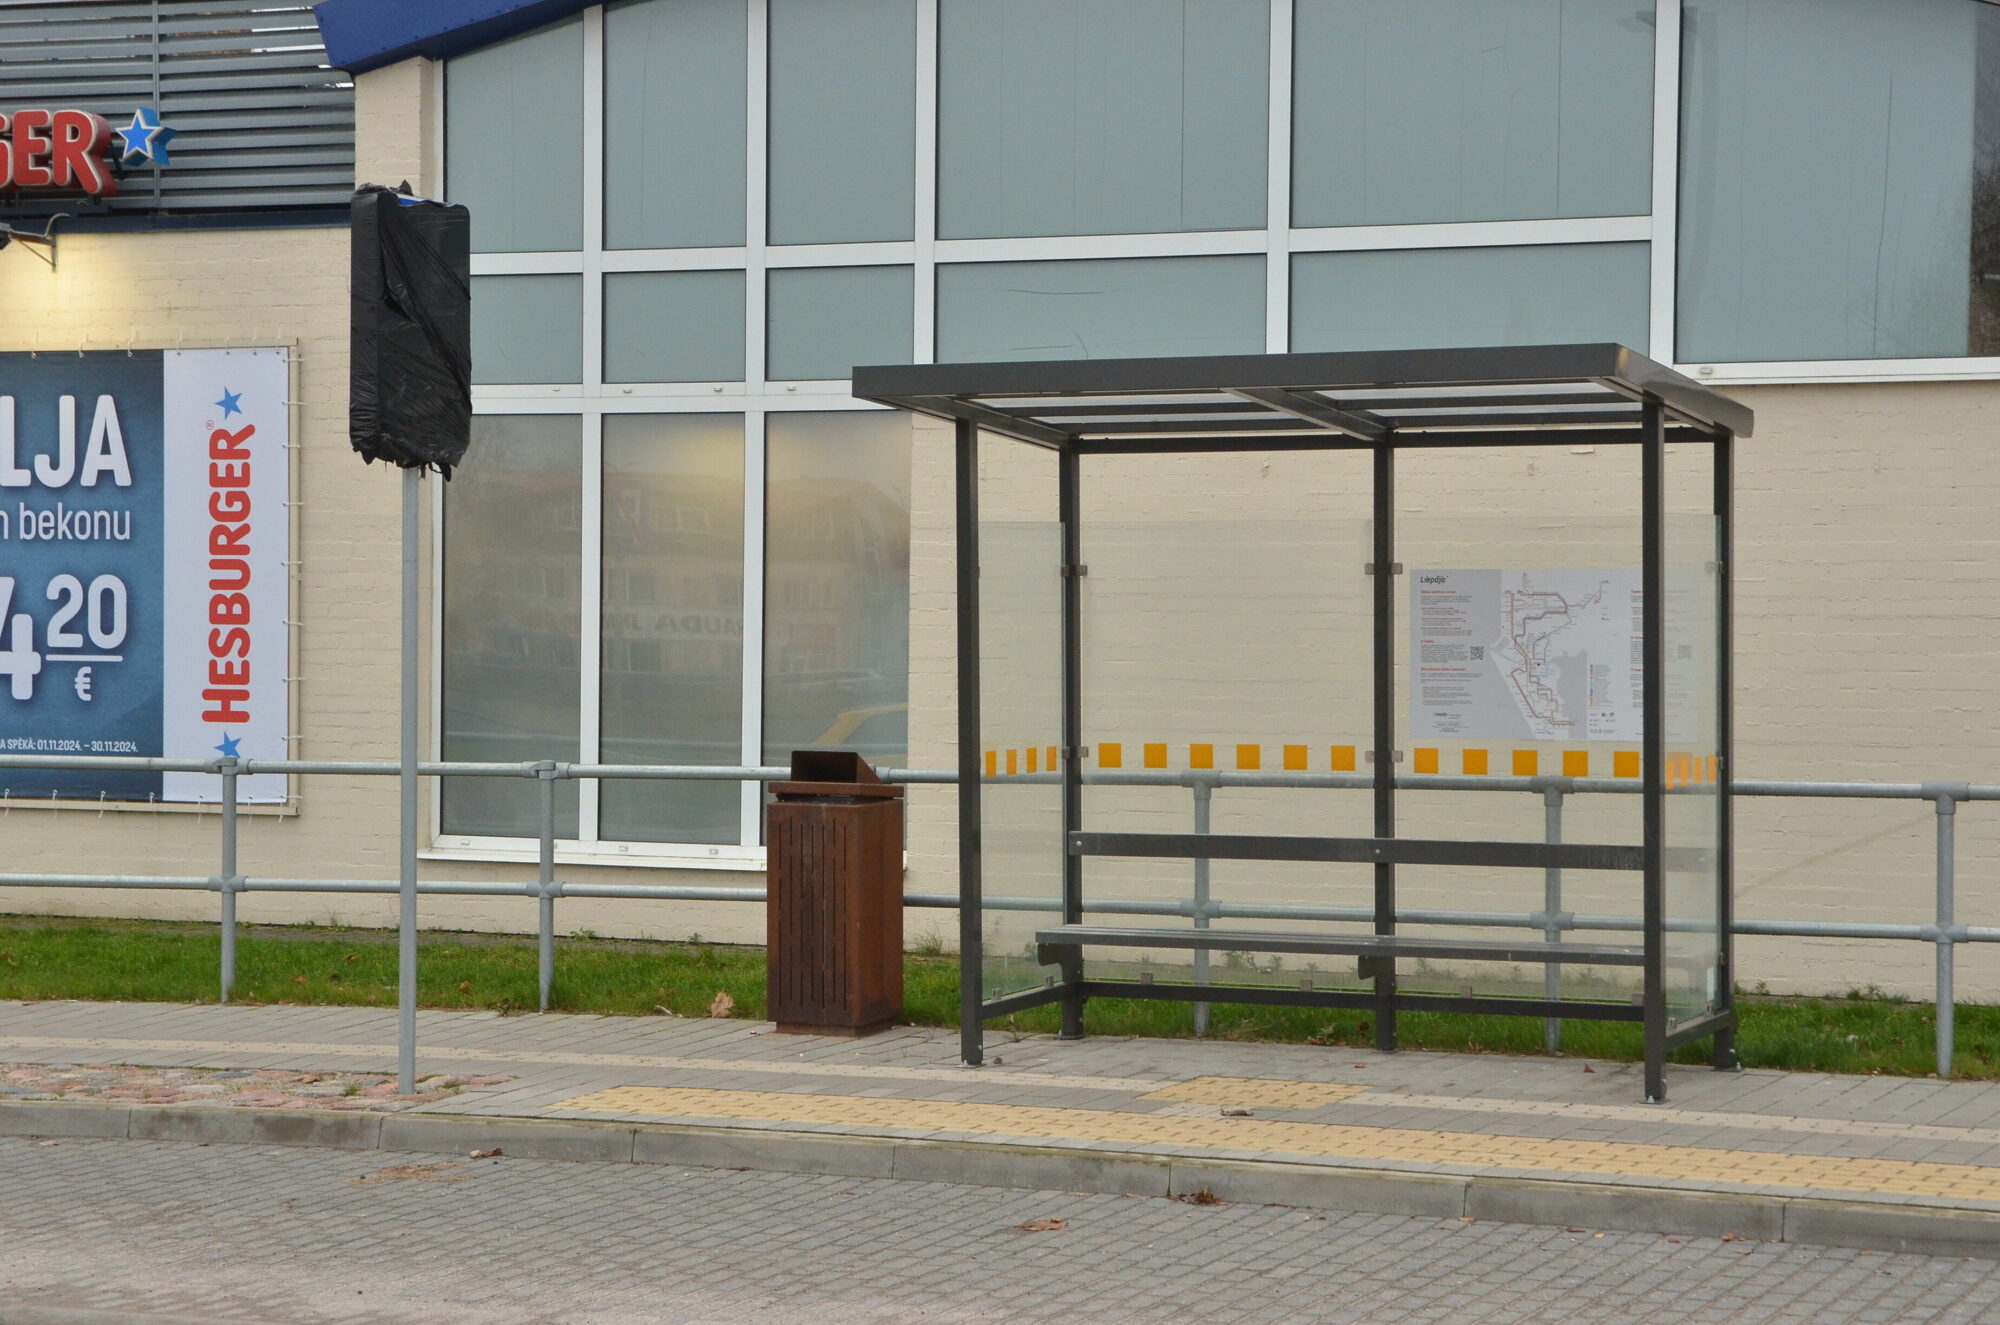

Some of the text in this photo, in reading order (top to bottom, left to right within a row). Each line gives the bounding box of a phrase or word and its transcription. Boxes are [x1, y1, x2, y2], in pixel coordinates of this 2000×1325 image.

[0, 109, 103, 195] ER
[0, 394, 132, 488] LJA
[19, 502, 130, 541] bekonu
[202, 424, 256, 723] HESBURGER
[74, 666, 92, 702] €
